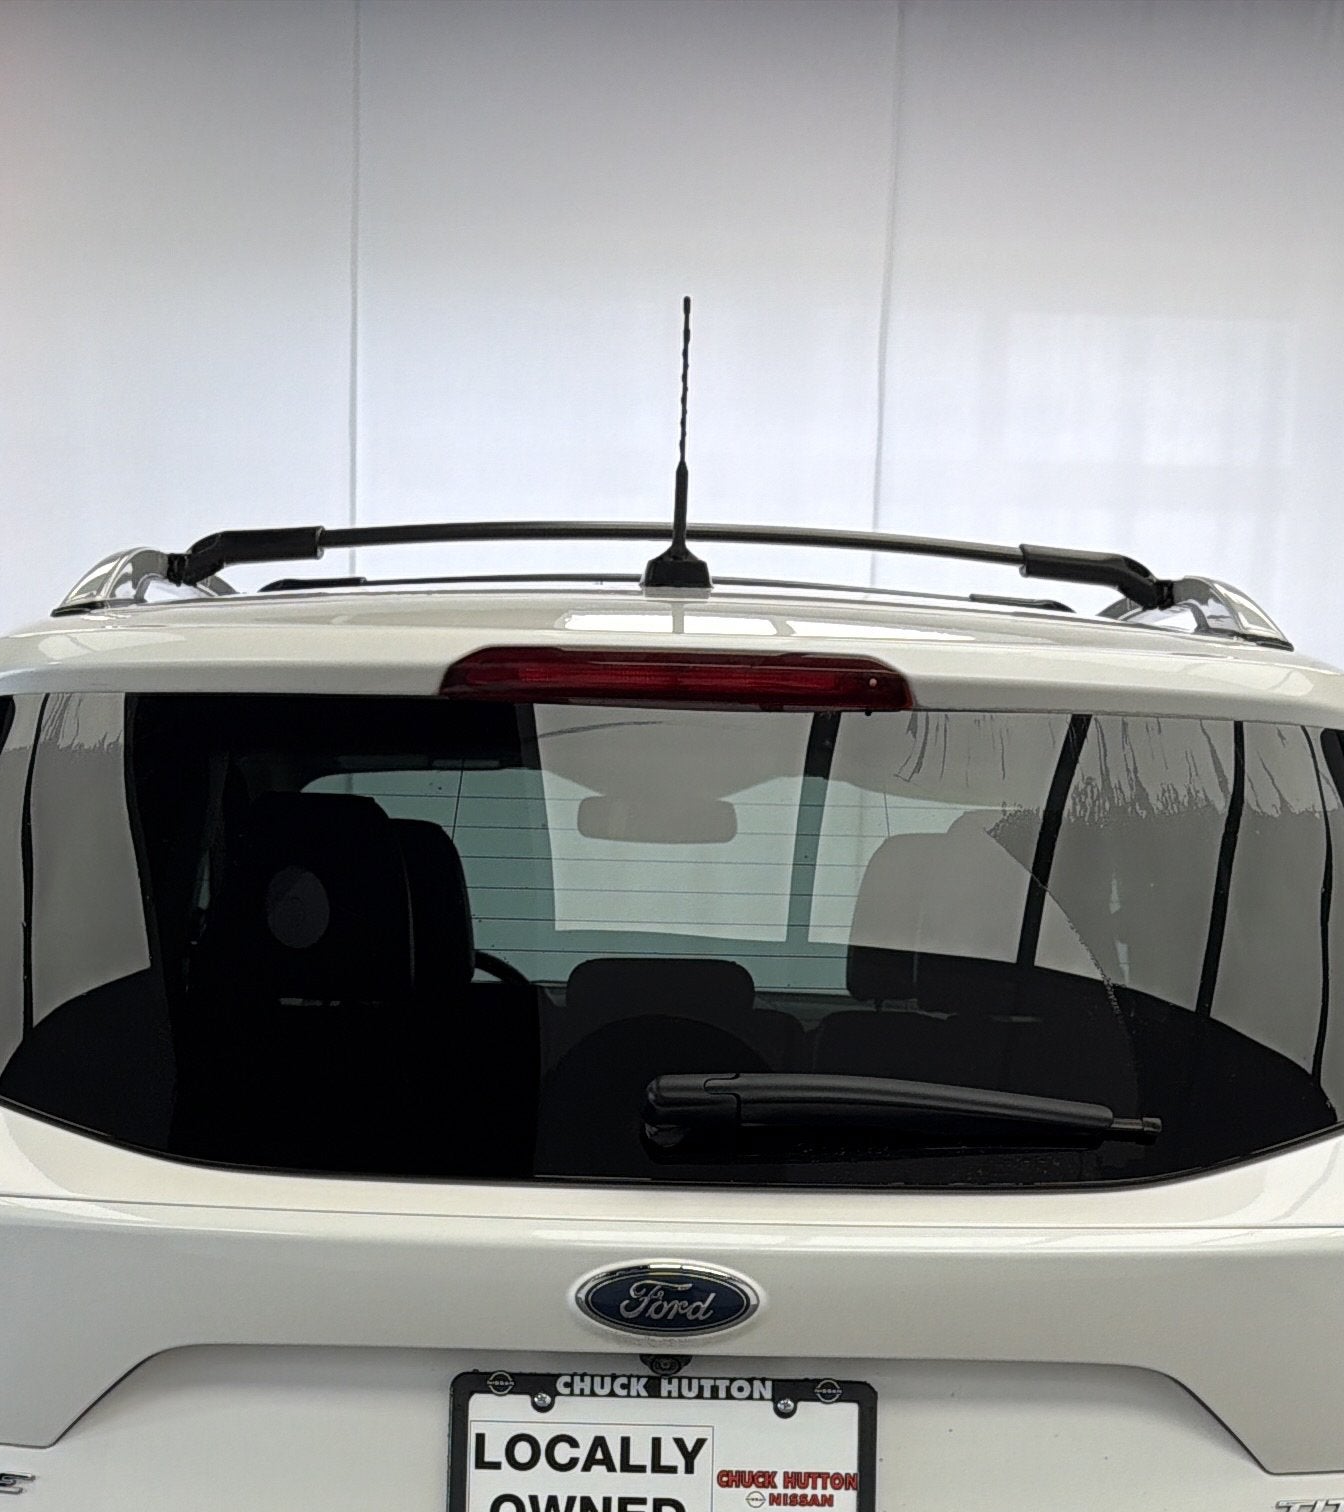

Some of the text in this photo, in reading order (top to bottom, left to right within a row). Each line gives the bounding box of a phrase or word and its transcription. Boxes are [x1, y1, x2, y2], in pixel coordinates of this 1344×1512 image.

[619, 1280, 714, 1322] Ford
[556, 1375, 773, 1399] CHUCK HUTTON
[474, 1432, 708, 1476] LOCALLY
[717, 1470, 859, 1491] CHUCK HUTTON
[769, 1493, 834, 1507] NISSAN
